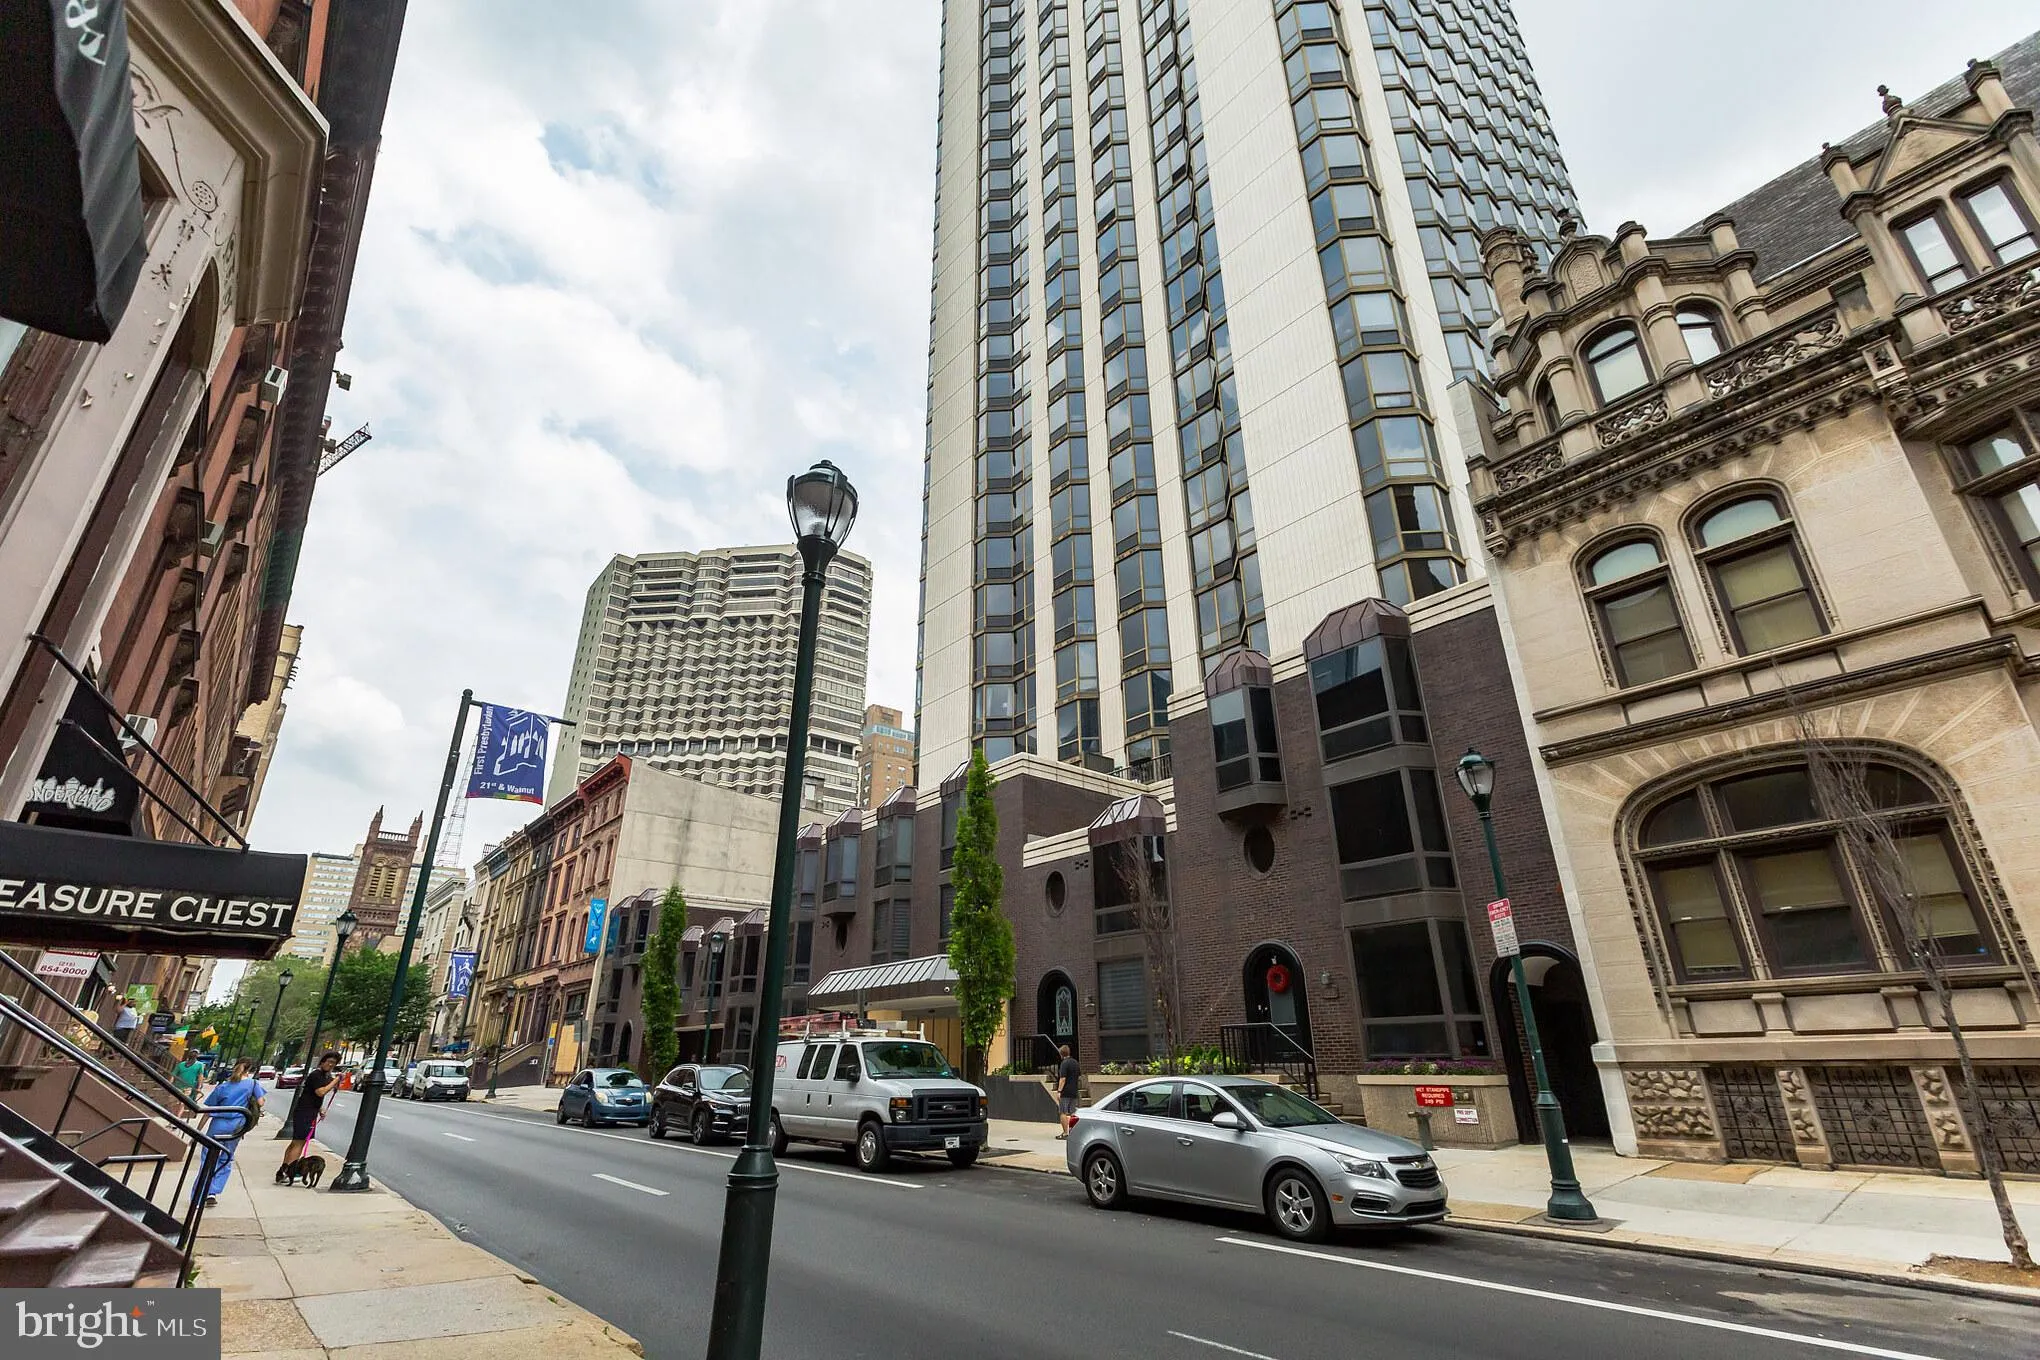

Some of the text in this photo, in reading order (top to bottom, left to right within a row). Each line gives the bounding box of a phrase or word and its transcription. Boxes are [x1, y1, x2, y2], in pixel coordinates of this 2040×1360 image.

[474, 705, 494, 775] First Presbyterian
[480, 781, 534, 794] 21st & Walnut
[0, 879, 292, 928] EASURE CHEST
[40, 965, 87, 975] 854-8000
